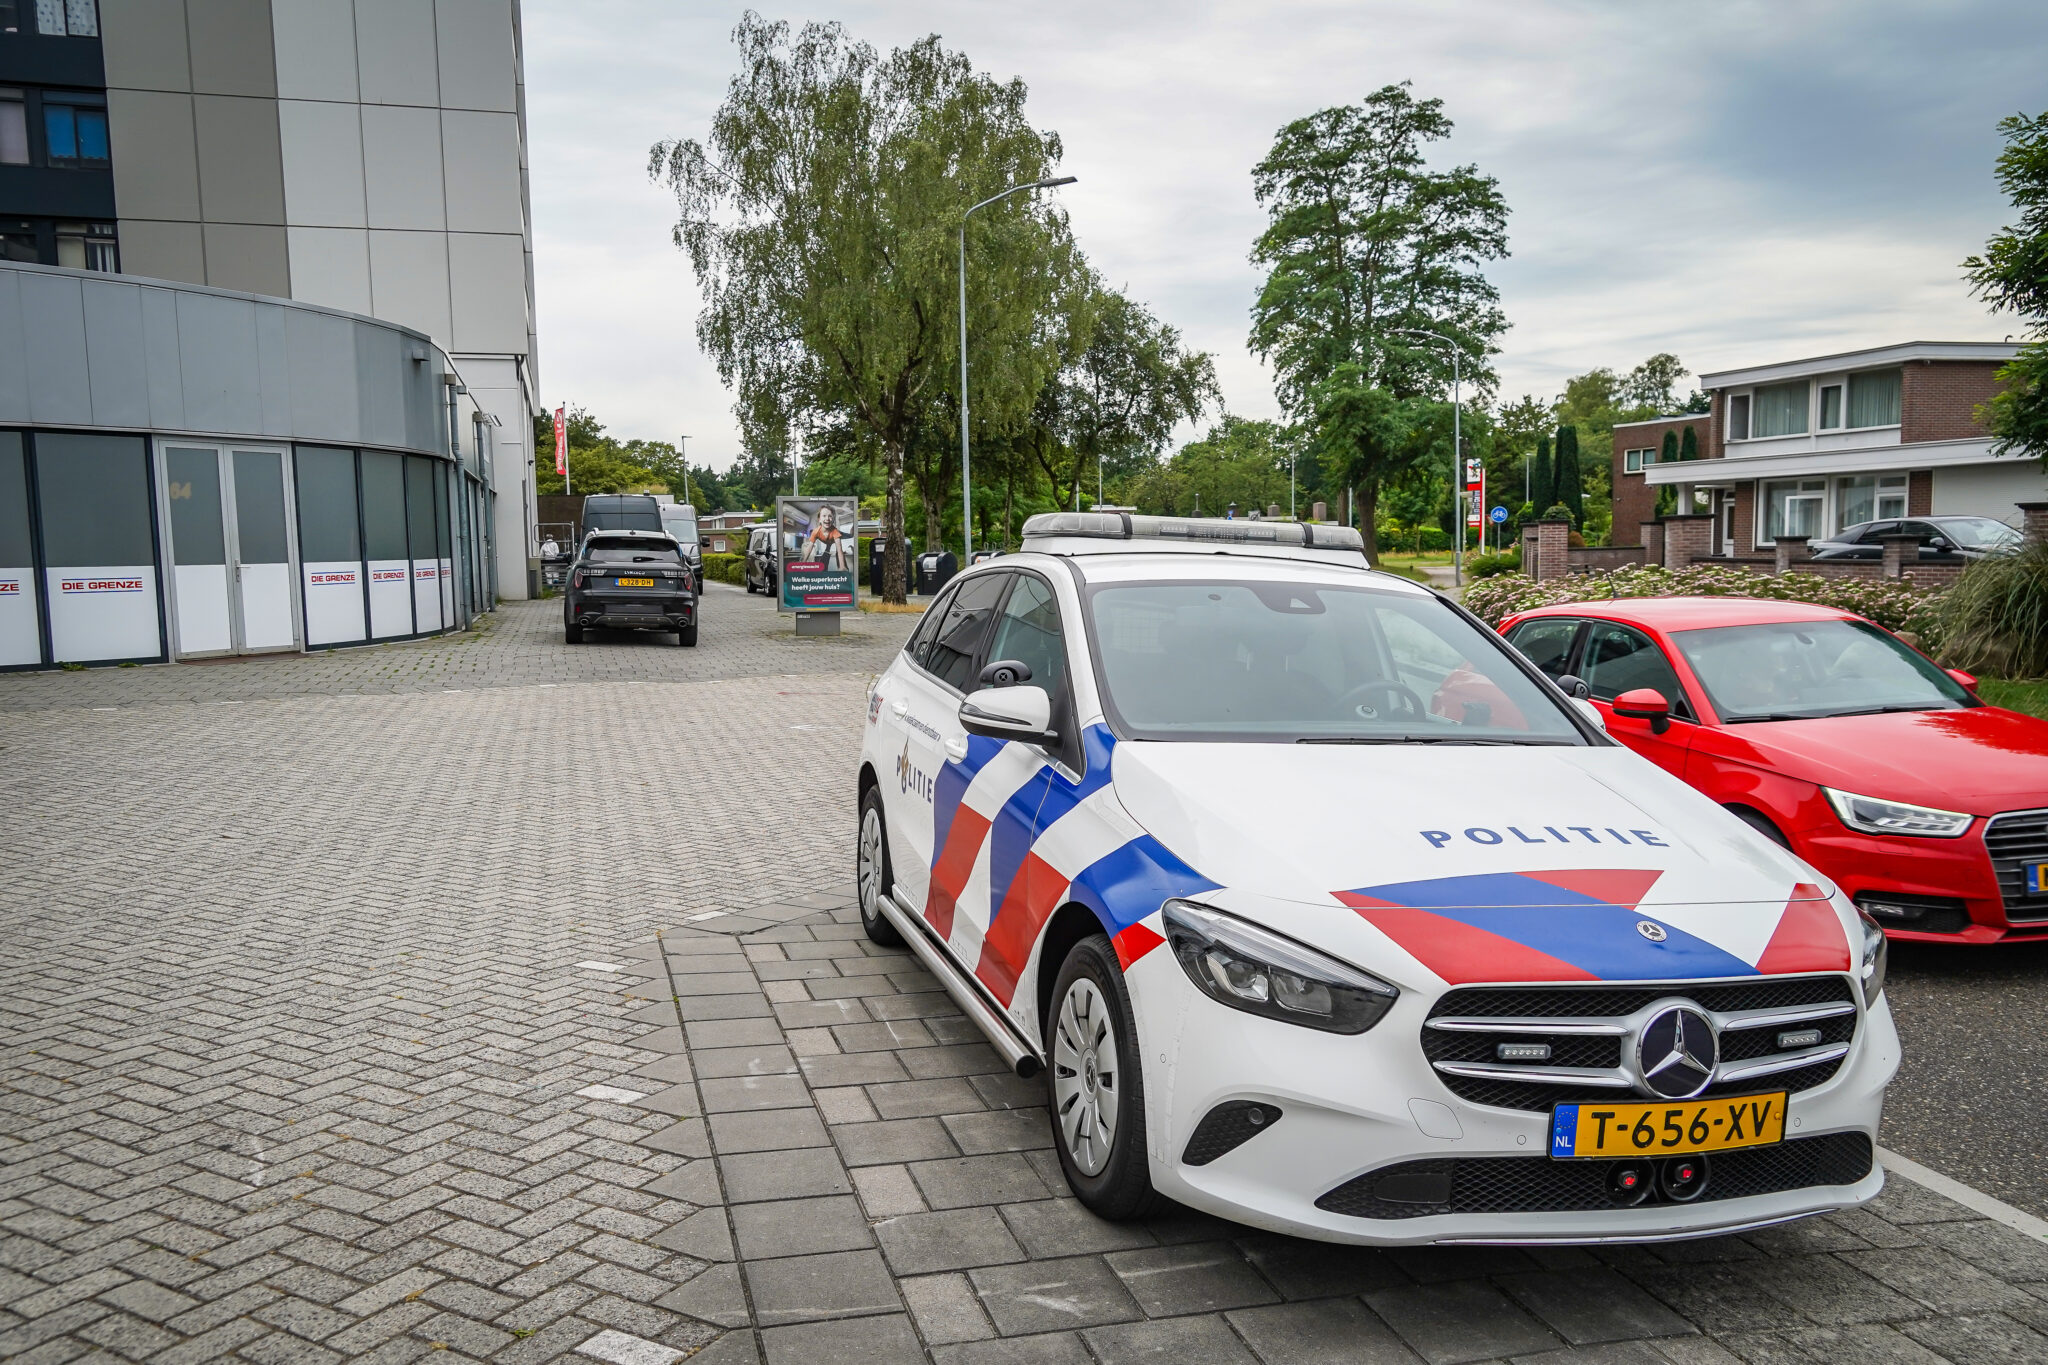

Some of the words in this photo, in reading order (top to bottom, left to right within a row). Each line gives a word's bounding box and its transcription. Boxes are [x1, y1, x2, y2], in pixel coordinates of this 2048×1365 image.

[170, 482, 191, 499] 64
[62, 582, 84, 590] DIE
[88, 581, 143, 589] GRENZE
[311, 575, 323, 583] DIE
[325, 574, 356, 582] GRENZE
[897, 754, 933, 803] POLITIE
[1419, 826, 1670, 848] POLITIE
[1555, 1136, 1572, 1148] NL
[1591, 1100, 1772, 1149] T-656-XV
